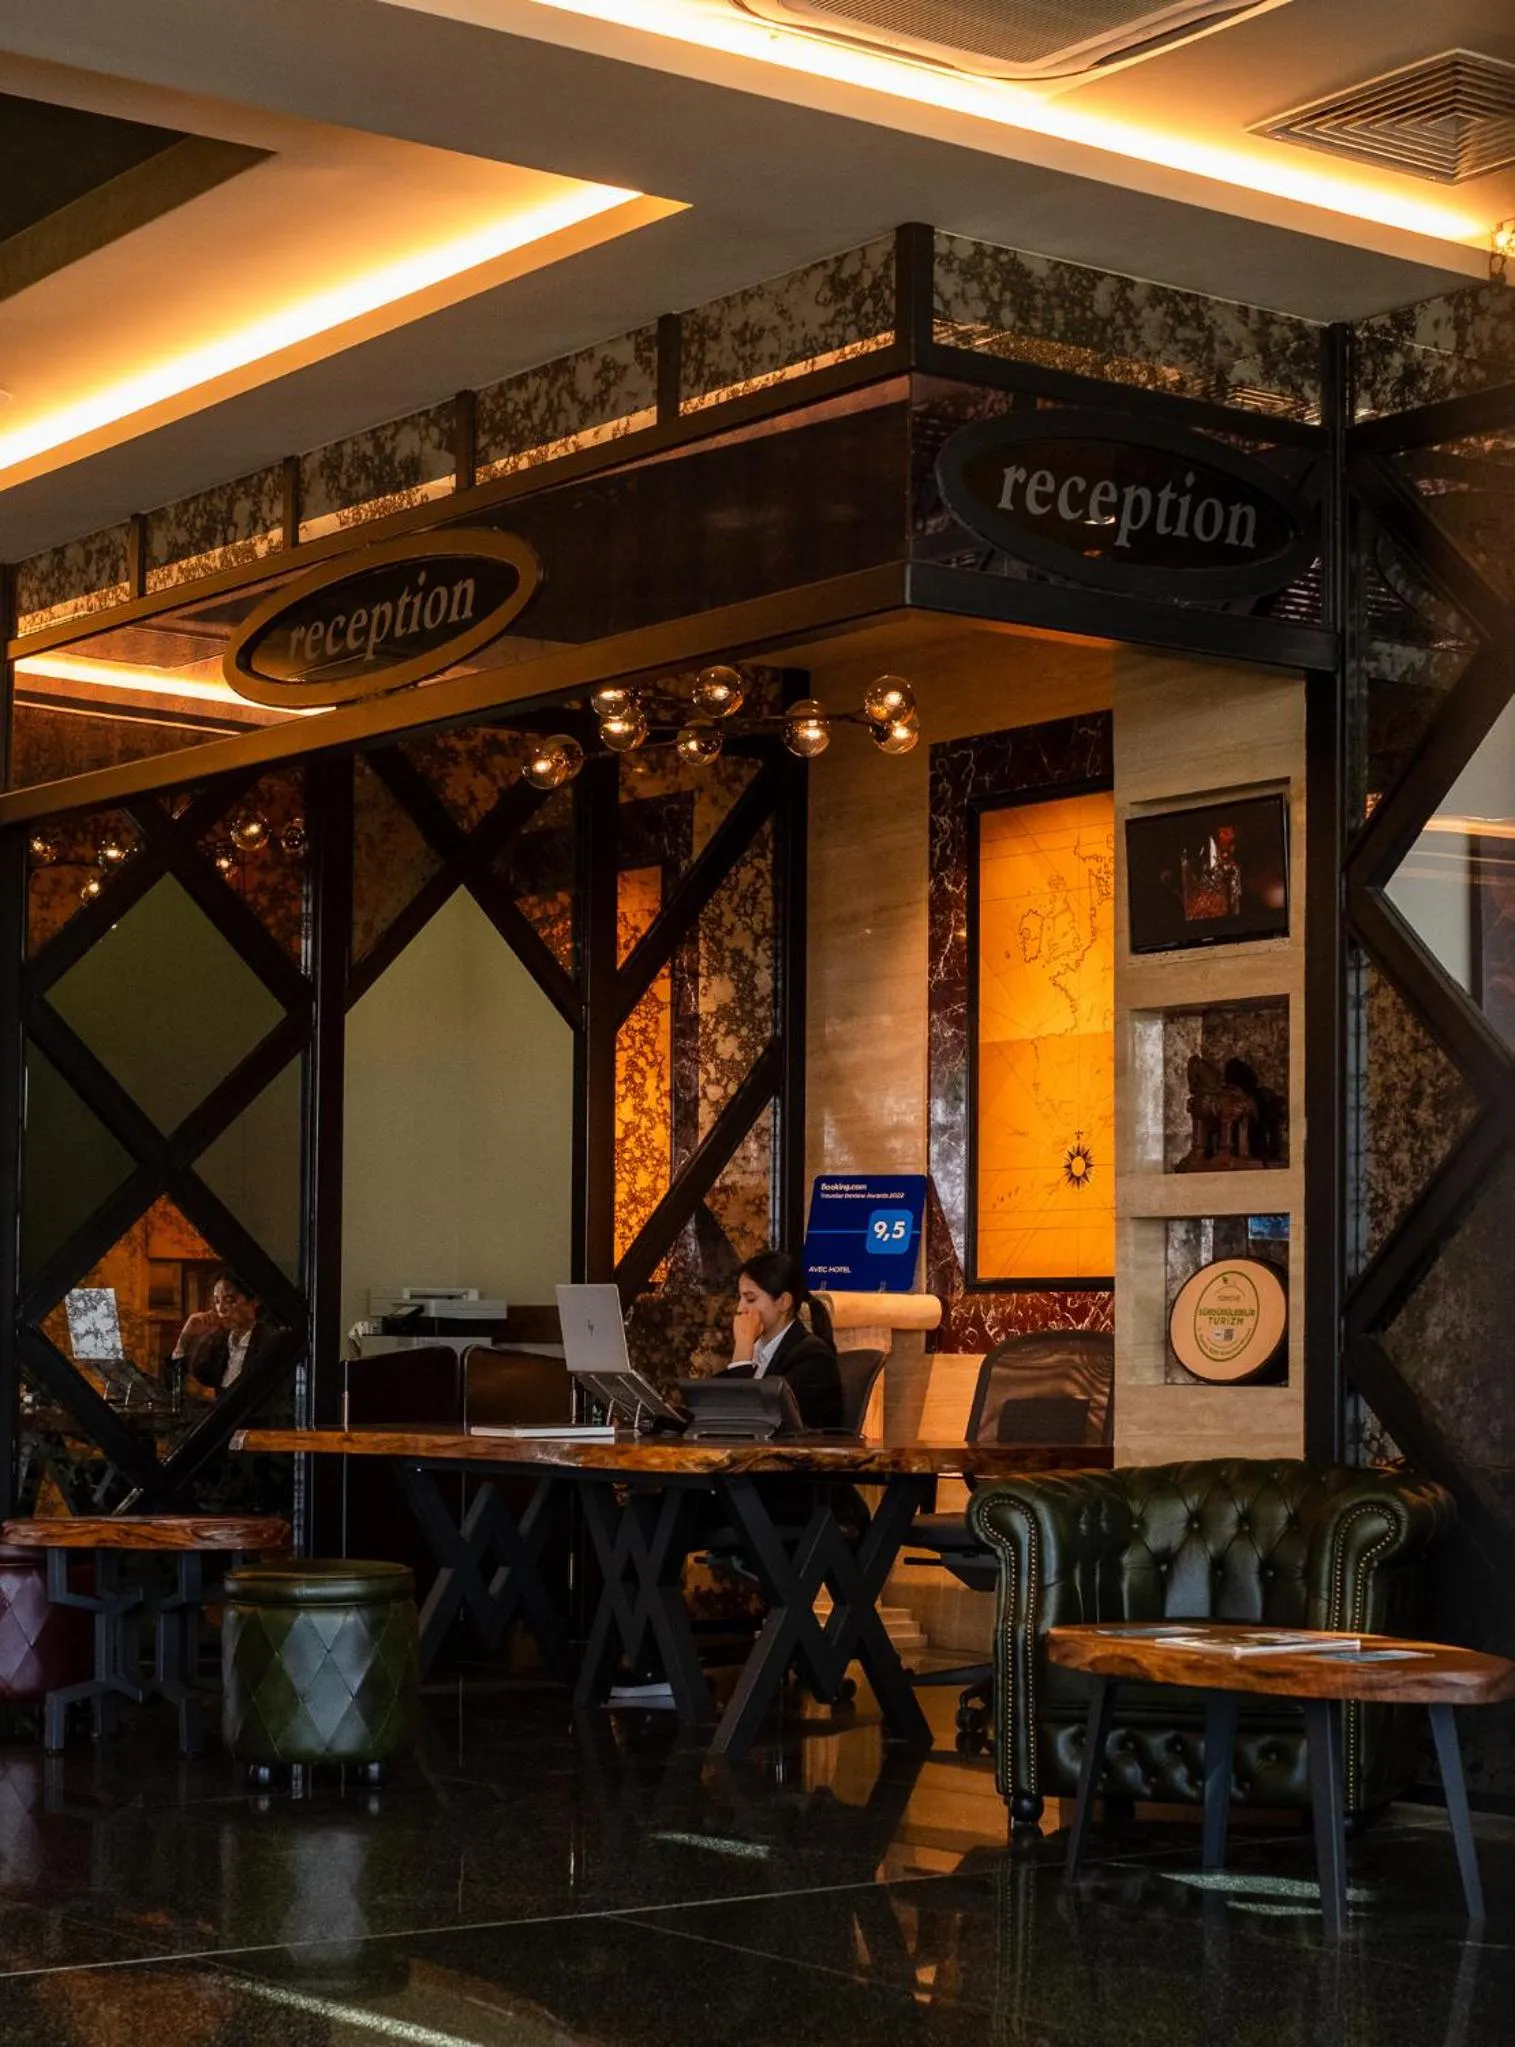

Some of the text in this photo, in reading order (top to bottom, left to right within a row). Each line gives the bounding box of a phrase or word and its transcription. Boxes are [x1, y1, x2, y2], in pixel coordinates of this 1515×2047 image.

[997, 463, 1256, 549] reception
[288, 570, 476, 662] reception
[820, 1183, 868, 1192] Booking.com
[873, 1220, 907, 1242] 9,5
[808, 1266, 852, 1274] AVEC HOTEL
